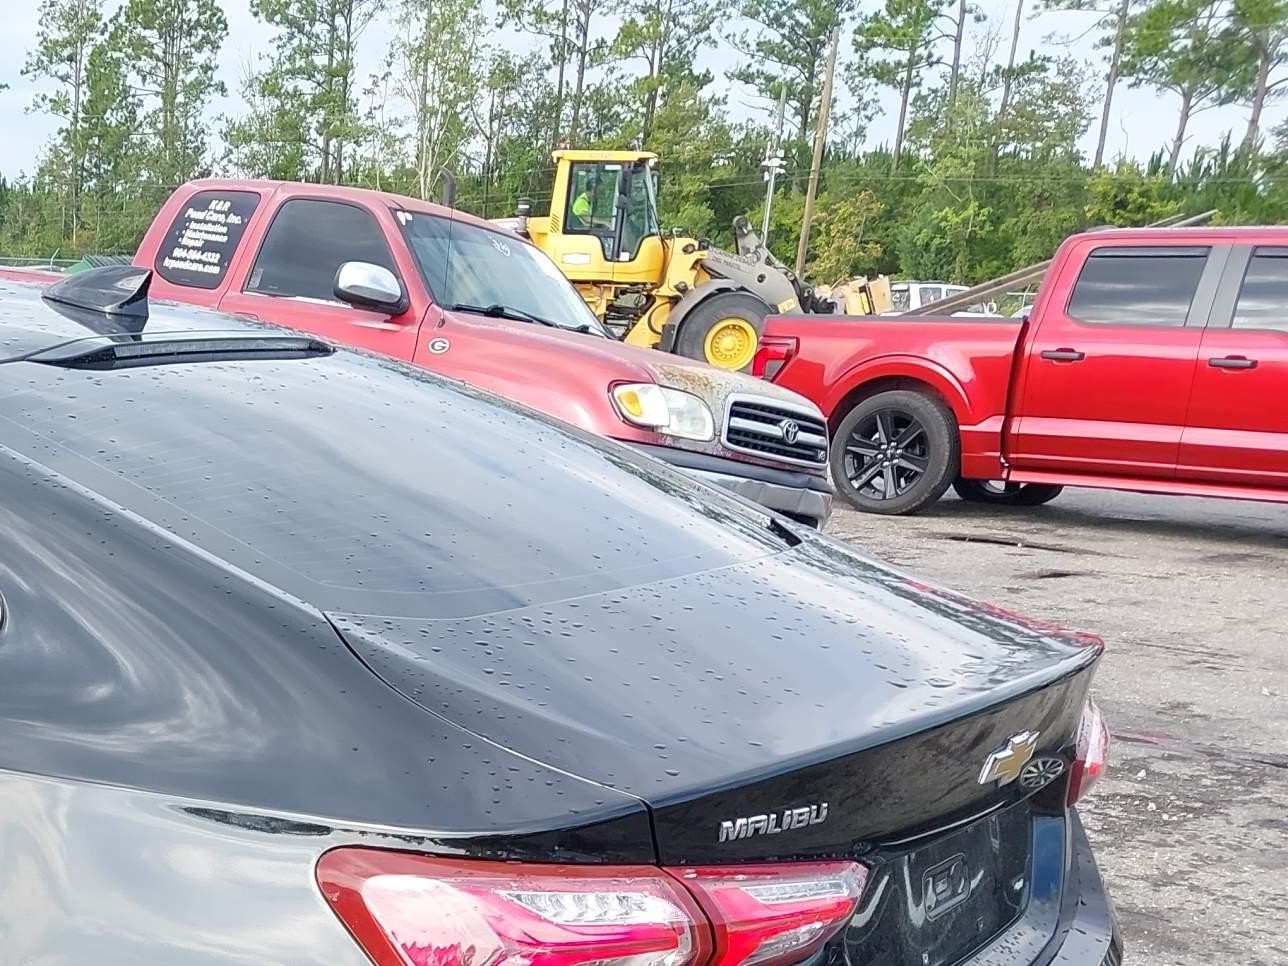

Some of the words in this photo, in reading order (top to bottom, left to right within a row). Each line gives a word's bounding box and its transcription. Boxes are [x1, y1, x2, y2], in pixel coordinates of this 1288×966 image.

[208, 200, 231, 211] K&R
[185, 208, 208, 220] Pond
[226, 213, 242, 224] Inc.
[189, 221, 228, 234] Installation
[185, 229, 228, 242] Maintenance
[181, 238, 205, 248] Repair
[719, 802, 829, 842] MALIBU
